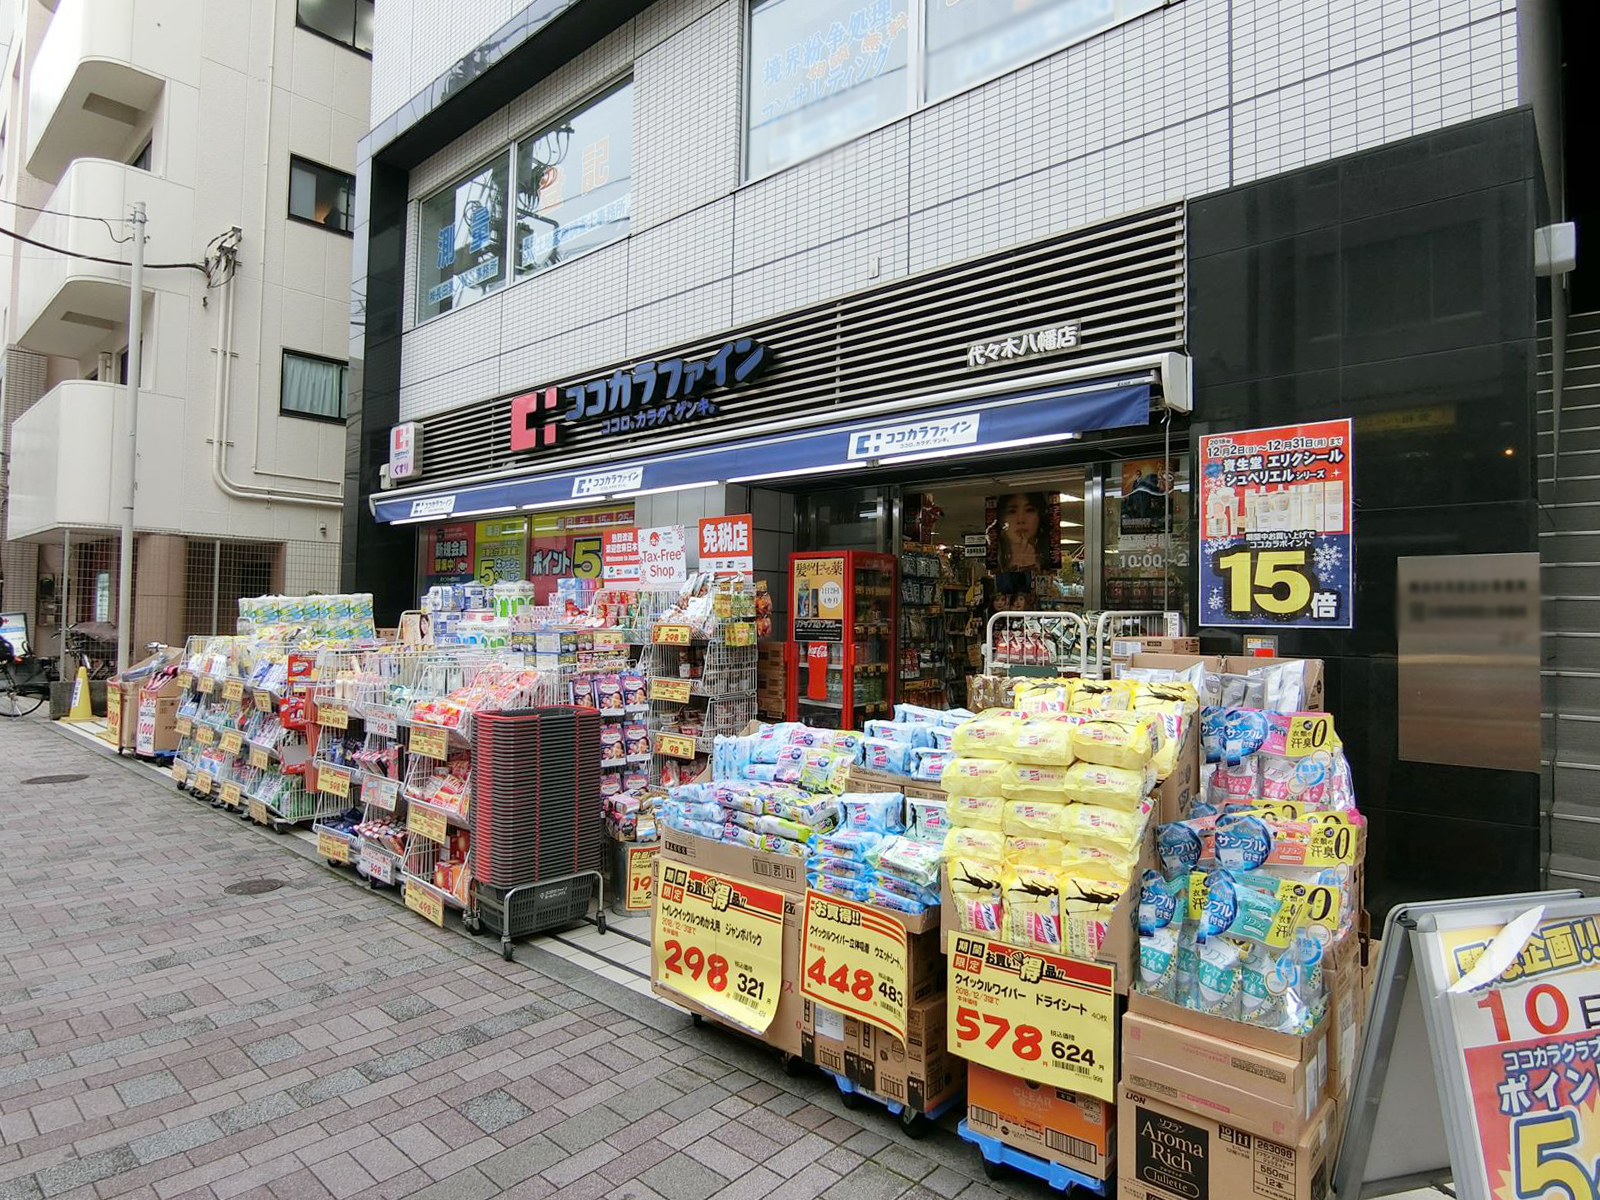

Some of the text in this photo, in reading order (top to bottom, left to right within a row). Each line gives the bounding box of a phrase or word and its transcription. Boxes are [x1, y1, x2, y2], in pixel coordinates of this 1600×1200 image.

[968, 326, 1078, 366] 代々木八幡店
[565, 338, 764, 421] ココカラファイン
[885, 421, 972, 444] ココカラファイン
[1223, 457, 1262, 473] 資生堂
[1267, 448, 1343, 469] エリクシール
[1226, 469, 1295, 487] シュペリエル
[1296, 470, 1325, 481] シリーズ
[702, 521, 748, 553] 免税店
[435, 540, 467, 558] 新規会員
[642, 549, 681, 563] Tax-Free
[532, 548, 571, 576] ポイント
[650, 565, 674, 579] Shop
[664, 634, 679, 642] 298
[669, 745, 678, 753] 98
[1218, 836, 1266, 851] サンプル
[1141, 890, 1175, 910] サンプル
[1204, 898, 1233, 917] ンプル
[814, 901, 861, 927] お買得!!
[726, 923, 762, 947] ジャンボパック
[956, 938, 985, 958] 期間
[664, 939, 729, 992] 298
[953, 953, 982, 975] 限定
[737, 973, 765, 1000] 321
[808, 956, 874, 1001] 448
[879, 982, 903, 1008] 483
[955, 973, 1026, 1000] クイックルワイパー
[1036, 993, 1087, 1016] ドライシート
[956, 1006, 1043, 1061] 578
[1050, 1029, 1075, 1041] 税込価格
[1051, 1041, 1095, 1067] 624
[1126, 1092, 1146, 1105] LION
[1499, 1069, 1600, 1116] ポイン
[1159, 1118, 1185, 1134] ソフラン
[1141, 1121, 1204, 1158] Aroma
[1257, 1140, 1293, 1159] 263098
[1151, 1141, 1193, 1173] Rich
[1153, 1172, 1188, 1193] Juliette
[1260, 1165, 1290, 1181] 550ml
[1265, 1177, 1285, 1190] 12本
